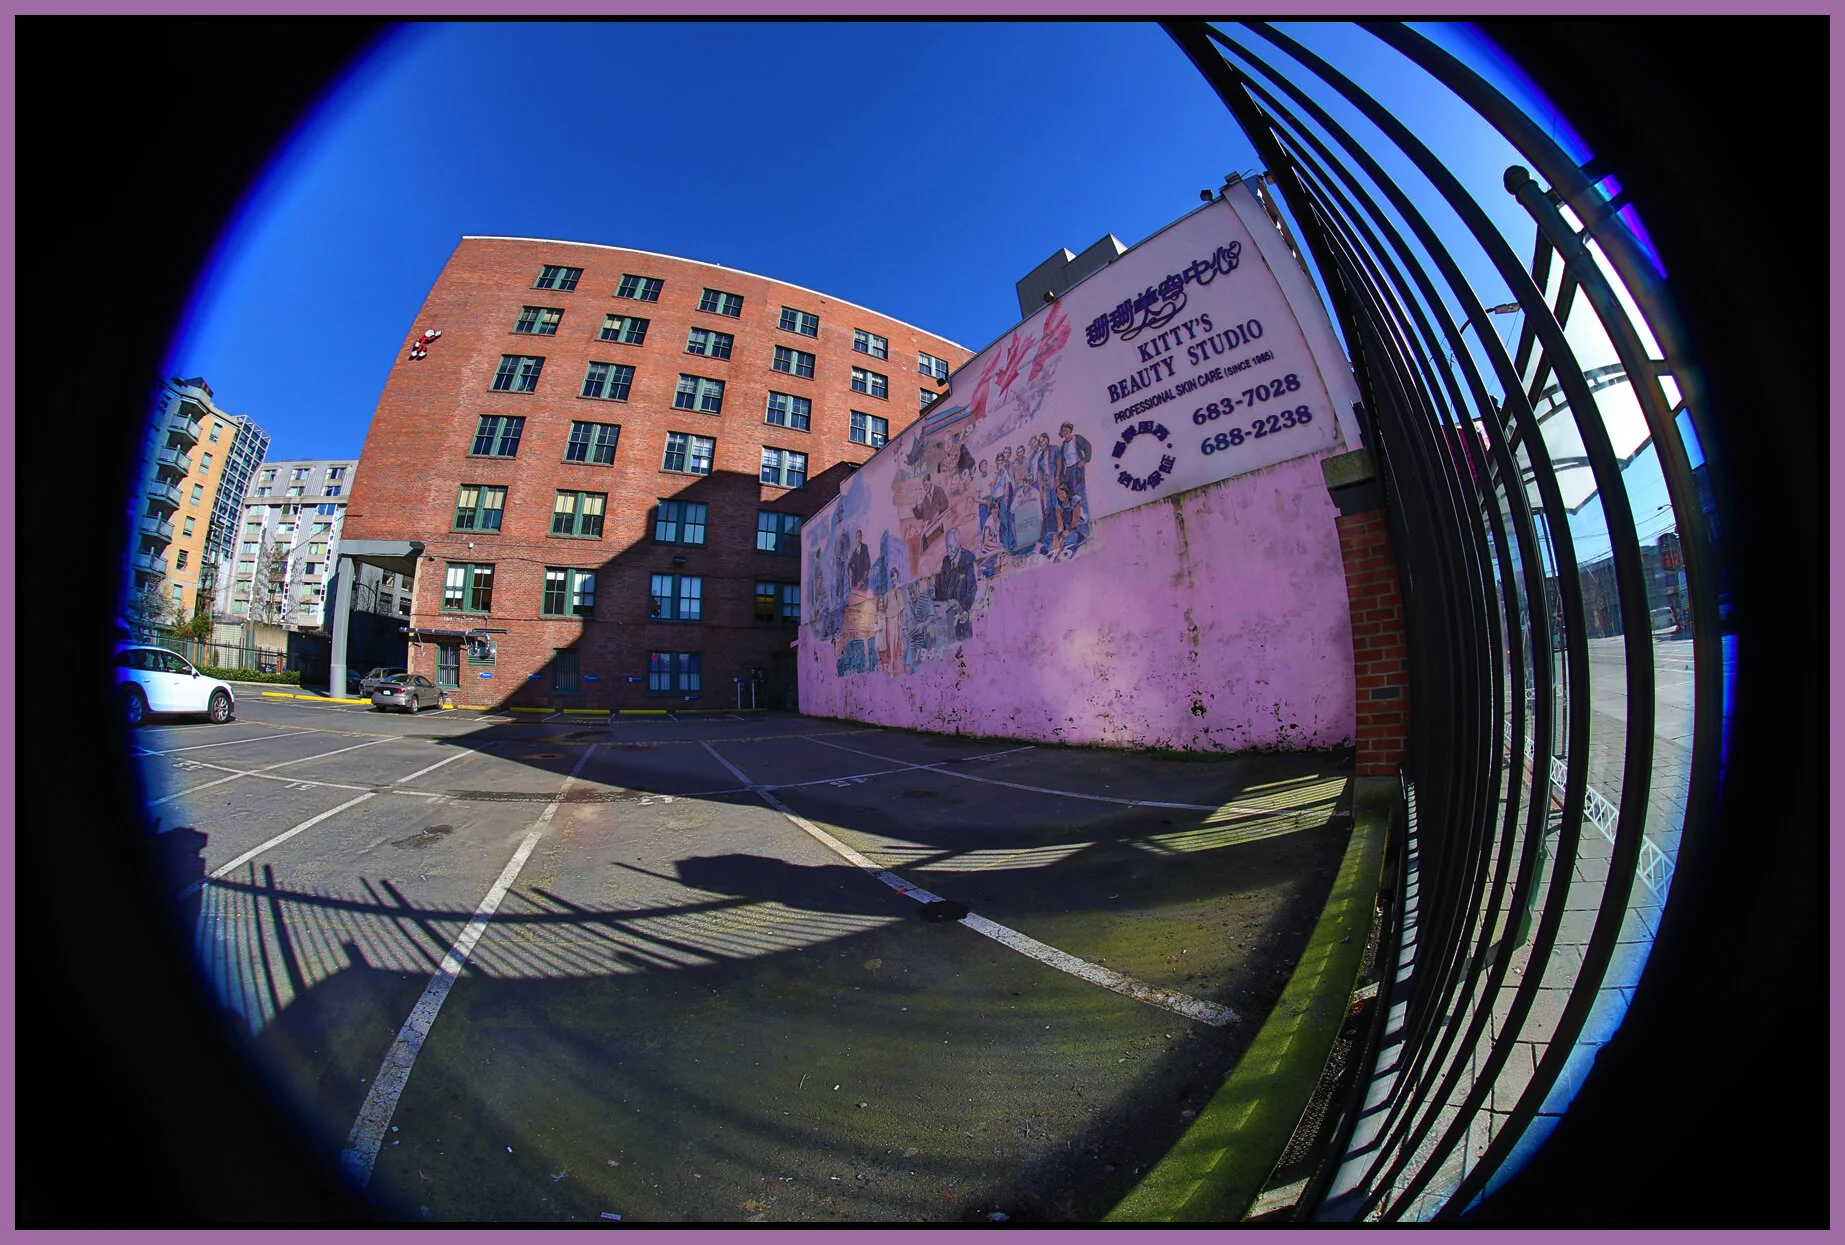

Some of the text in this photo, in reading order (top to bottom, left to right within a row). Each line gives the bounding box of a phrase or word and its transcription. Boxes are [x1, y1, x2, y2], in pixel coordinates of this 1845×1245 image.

[1107, 318, 1263, 403] BEAUTY STUDIO
[1138, 314, 1213, 363] KITTY'S
[1114, 388, 1176, 424] PROFESSIONAL
[1175, 379, 1198, 397] SKIN
[1197, 367, 1224, 388] CARE
[1223, 359, 1252, 378] (SINCE
[1192, 373, 1301, 426] 683-7028
[1200, 405, 1313, 456] 688-2238
